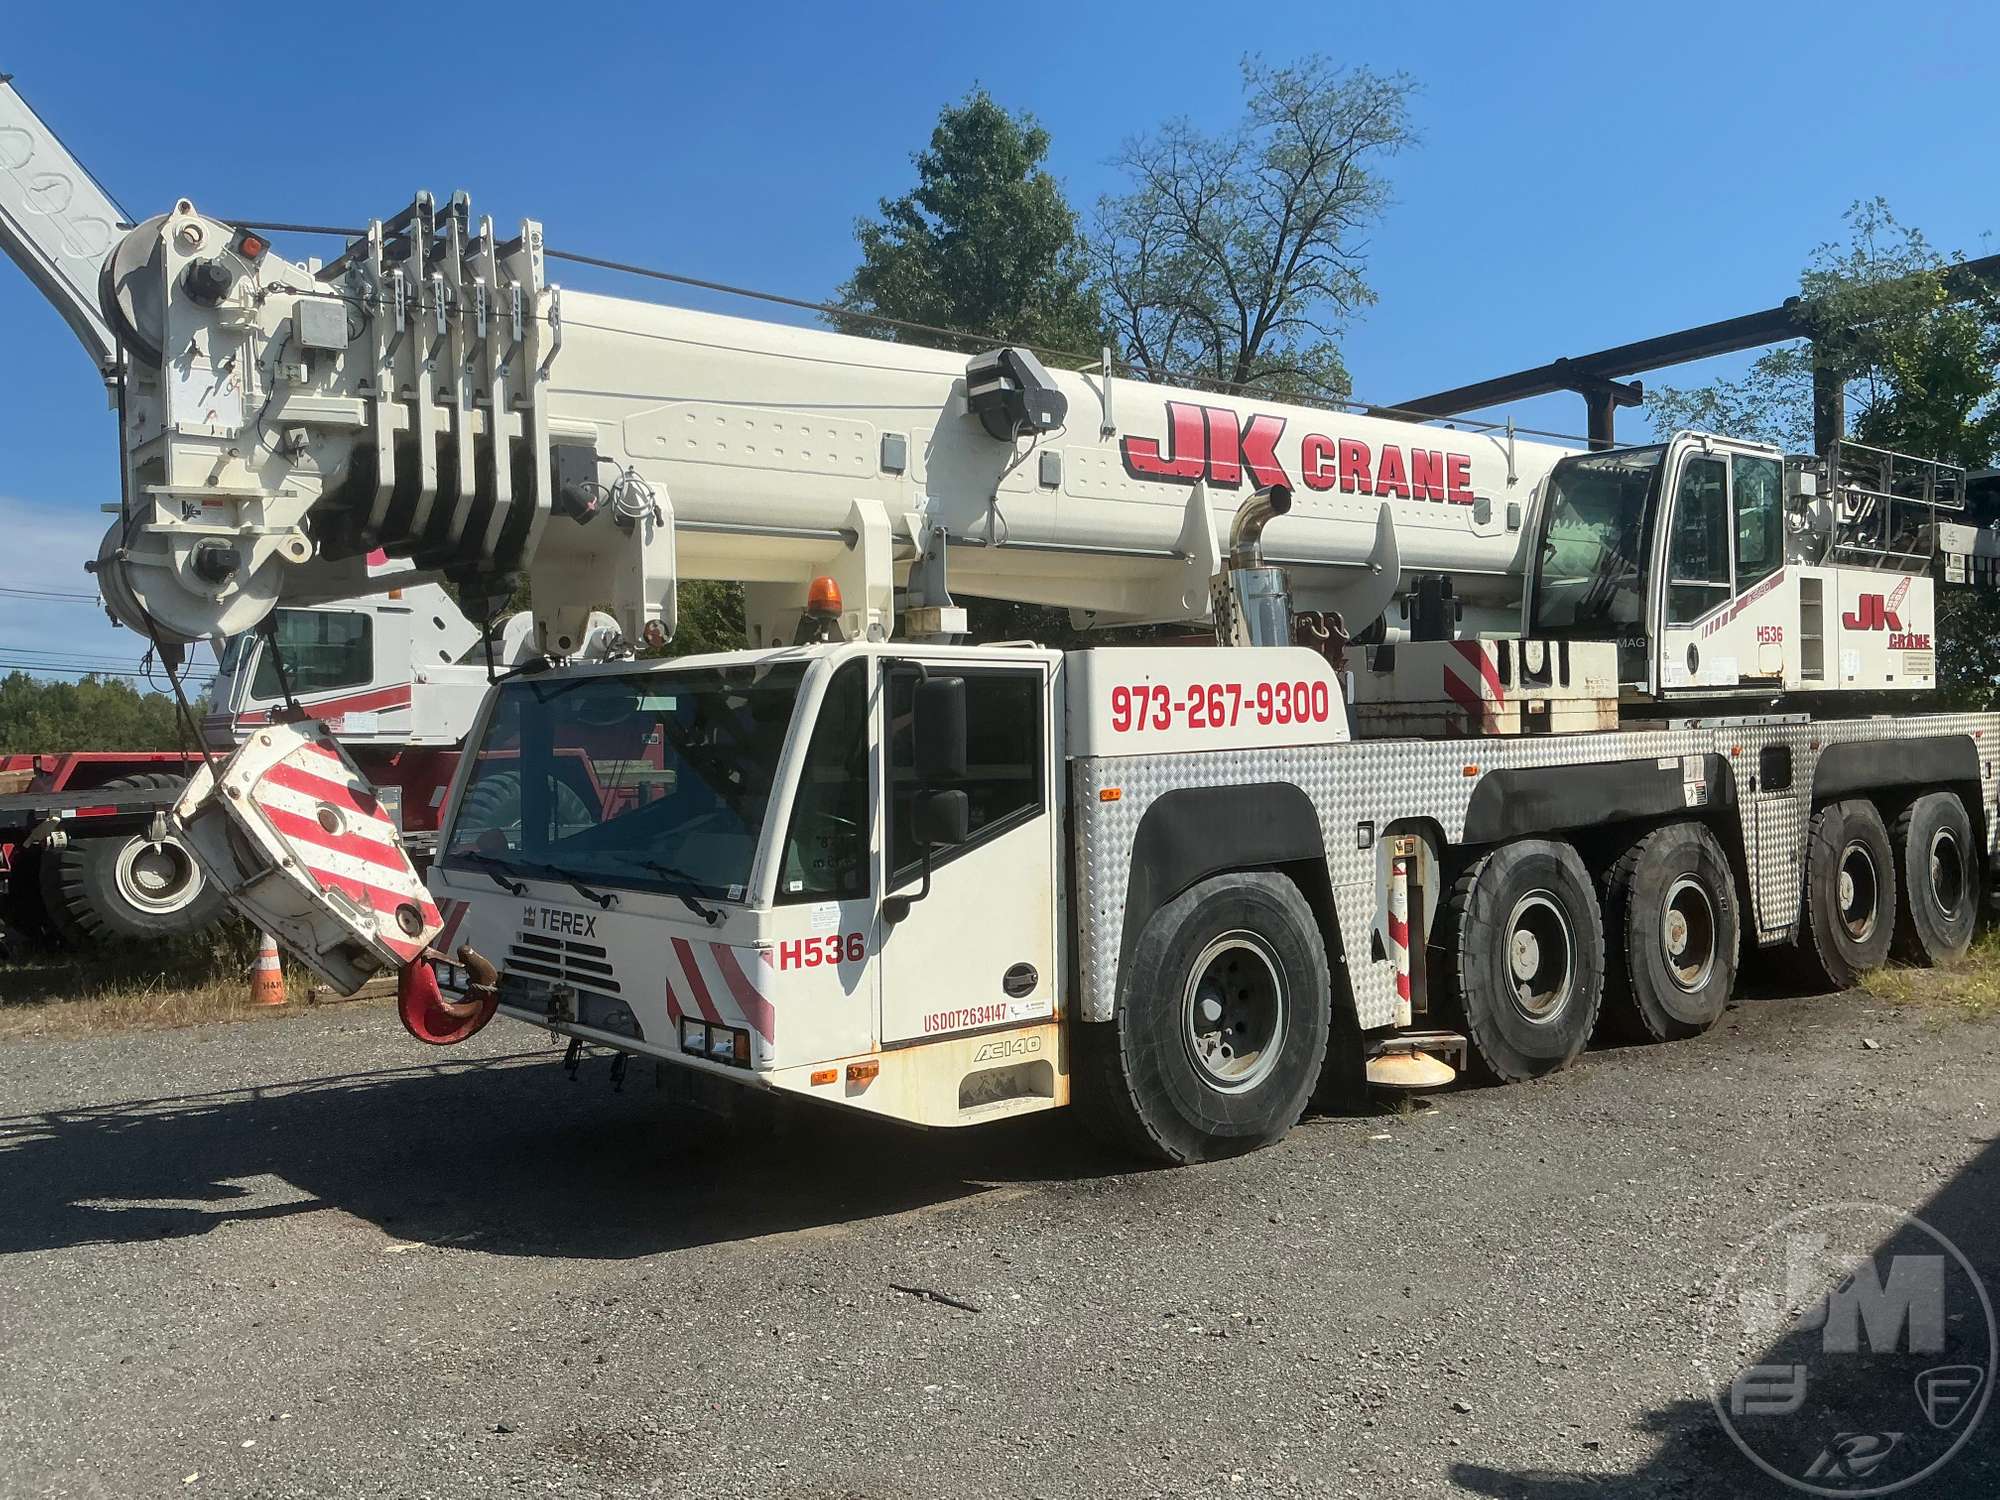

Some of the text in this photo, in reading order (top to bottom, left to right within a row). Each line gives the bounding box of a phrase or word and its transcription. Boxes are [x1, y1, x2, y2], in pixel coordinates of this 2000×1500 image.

[1120, 400, 1474, 505] JK CRANE
[1842, 592, 1904, 631] JK
[1757, 626, 1783, 642] H536
[1888, 633, 1931, 649] CRANE
[1112, 681, 1329, 732] 973-267-9300
[540, 908, 597, 938] TEREX
[780, 932, 865, 971] H536
[924, 1003, 1007, 1032] USDOT2634147
[973, 1036, 1041, 1062] AC140
